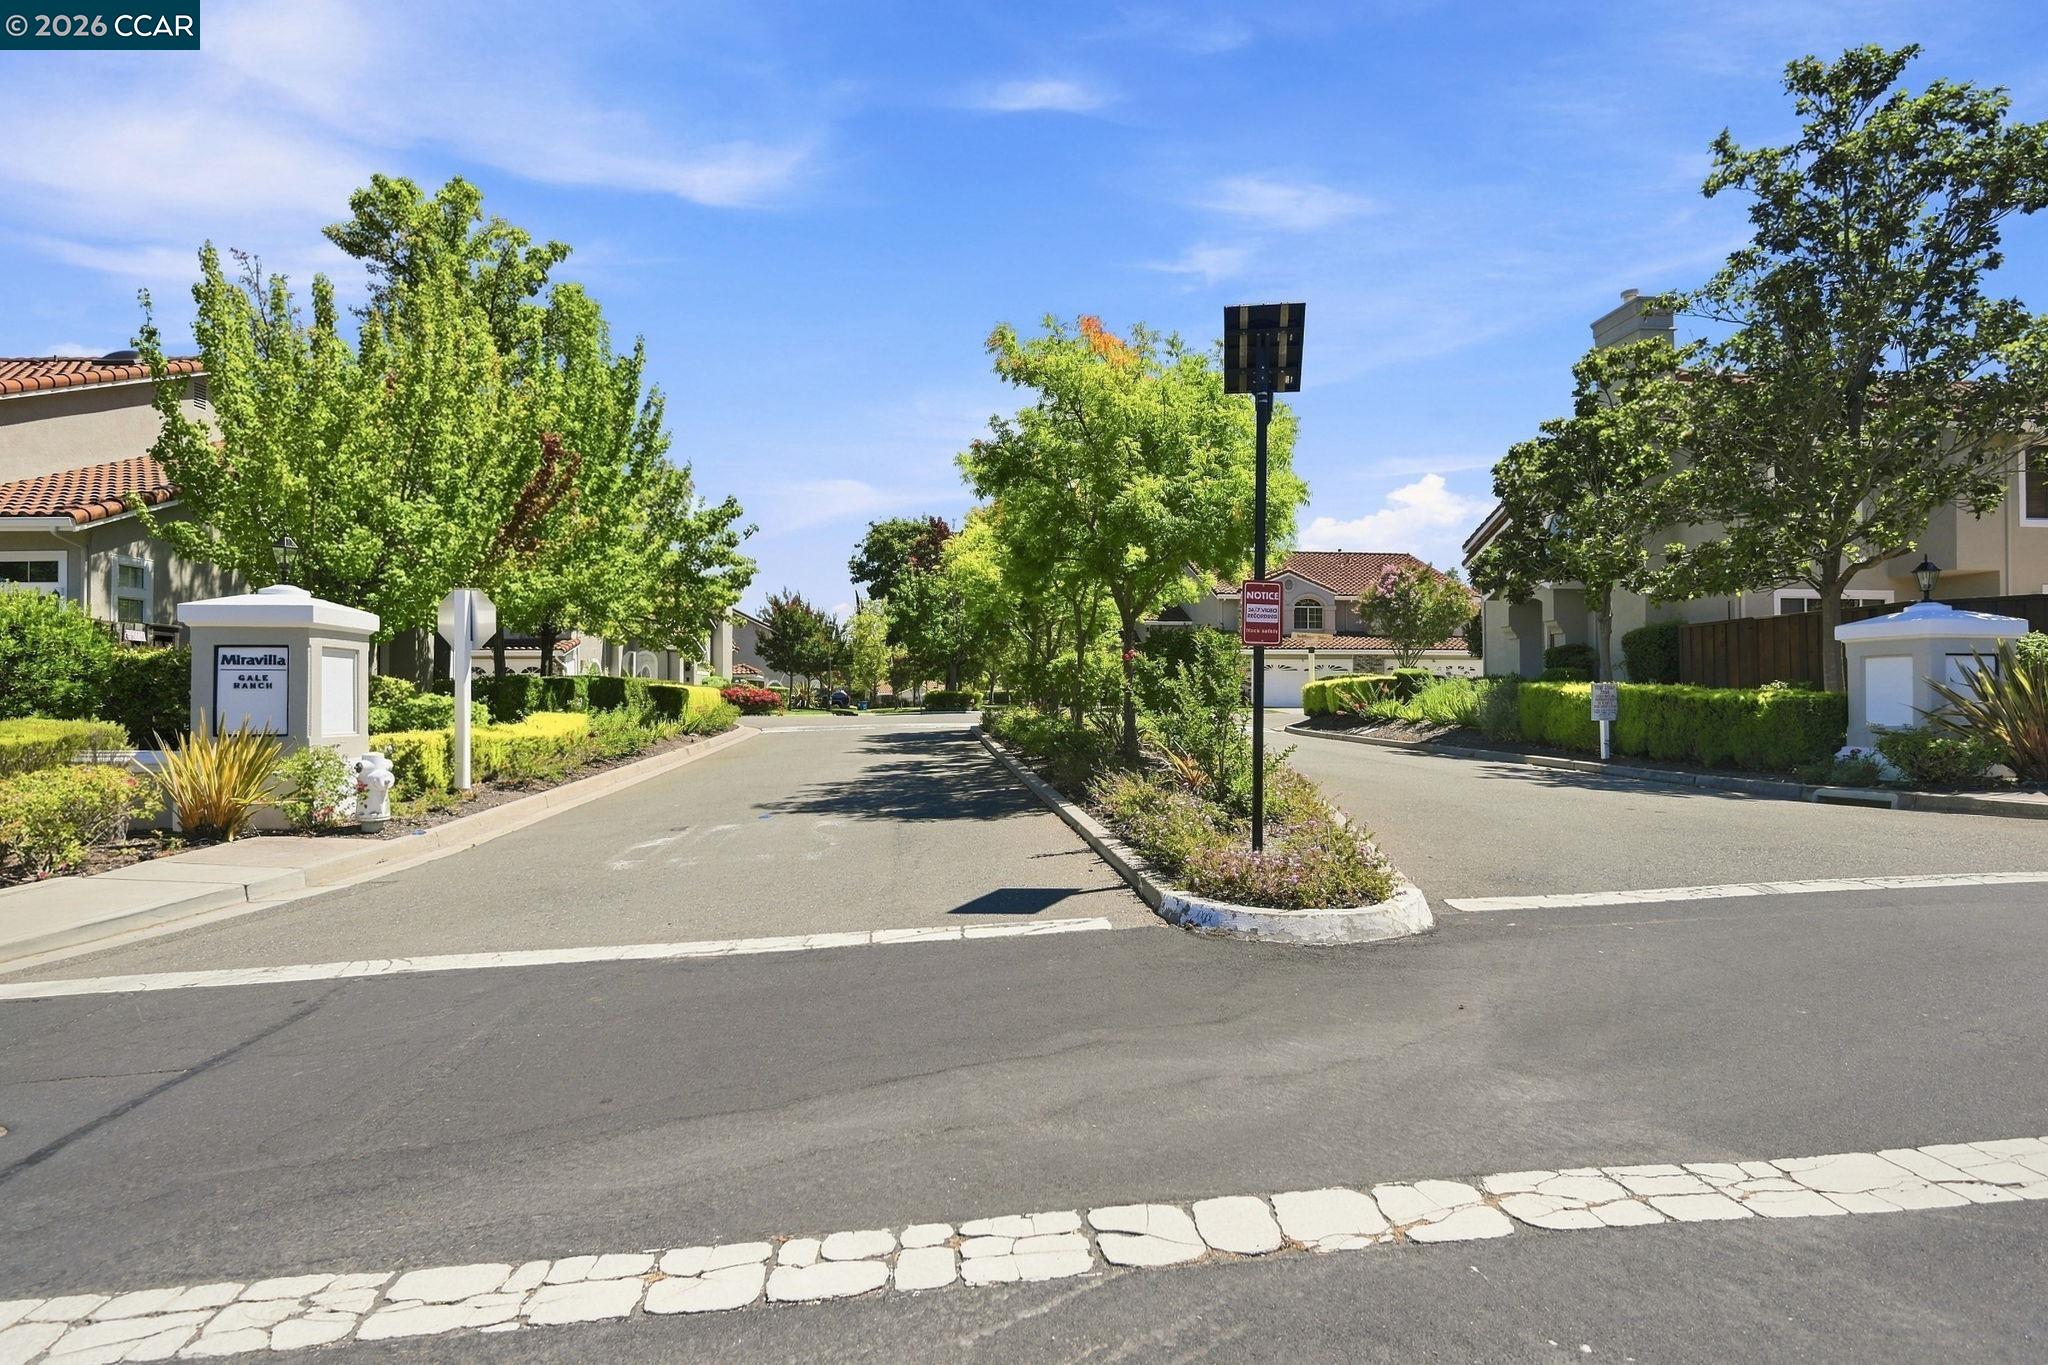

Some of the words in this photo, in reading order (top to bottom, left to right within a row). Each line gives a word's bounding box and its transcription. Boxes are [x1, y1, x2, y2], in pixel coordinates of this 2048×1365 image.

[1246, 591, 1279, 600] NOTICE
[220, 654, 286, 666] Miravilla
[238, 674, 269, 682] GALE
[233, 682, 273, 690] RANCH
